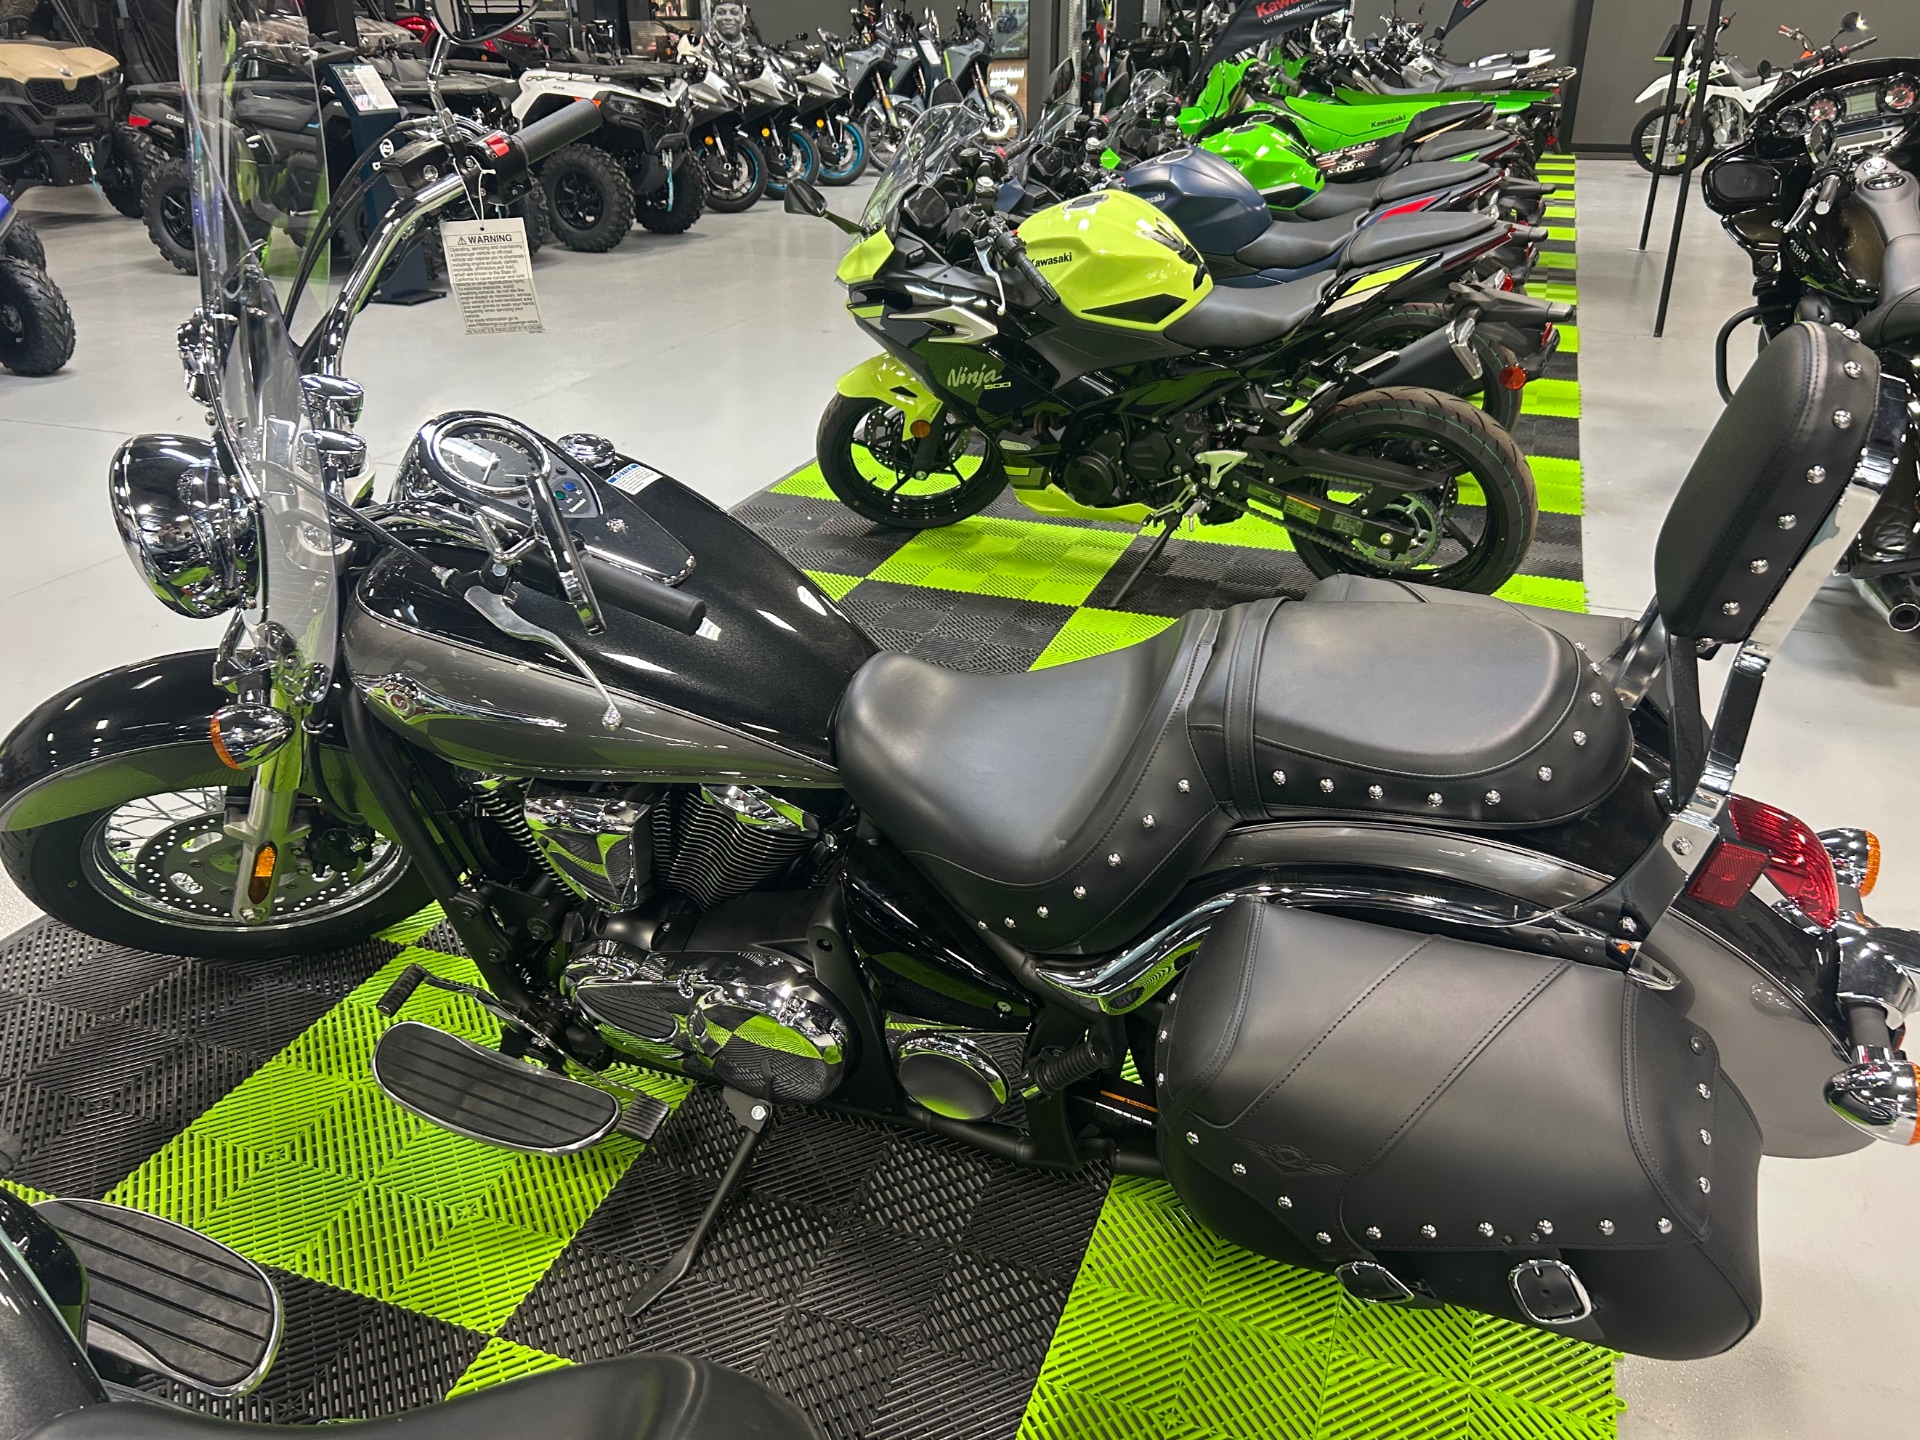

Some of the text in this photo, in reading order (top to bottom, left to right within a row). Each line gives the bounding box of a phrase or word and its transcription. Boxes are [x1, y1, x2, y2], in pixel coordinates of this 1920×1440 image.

[1263, 17, 1273, 25] Let
[1284, 7, 1301, 17] Good
[1371, 115, 1406, 128] Kawasaki
[468, 234, 512, 243] WARNING
[947, 364, 1003, 391] Ninja
[984, 381, 1011, 390] 500
